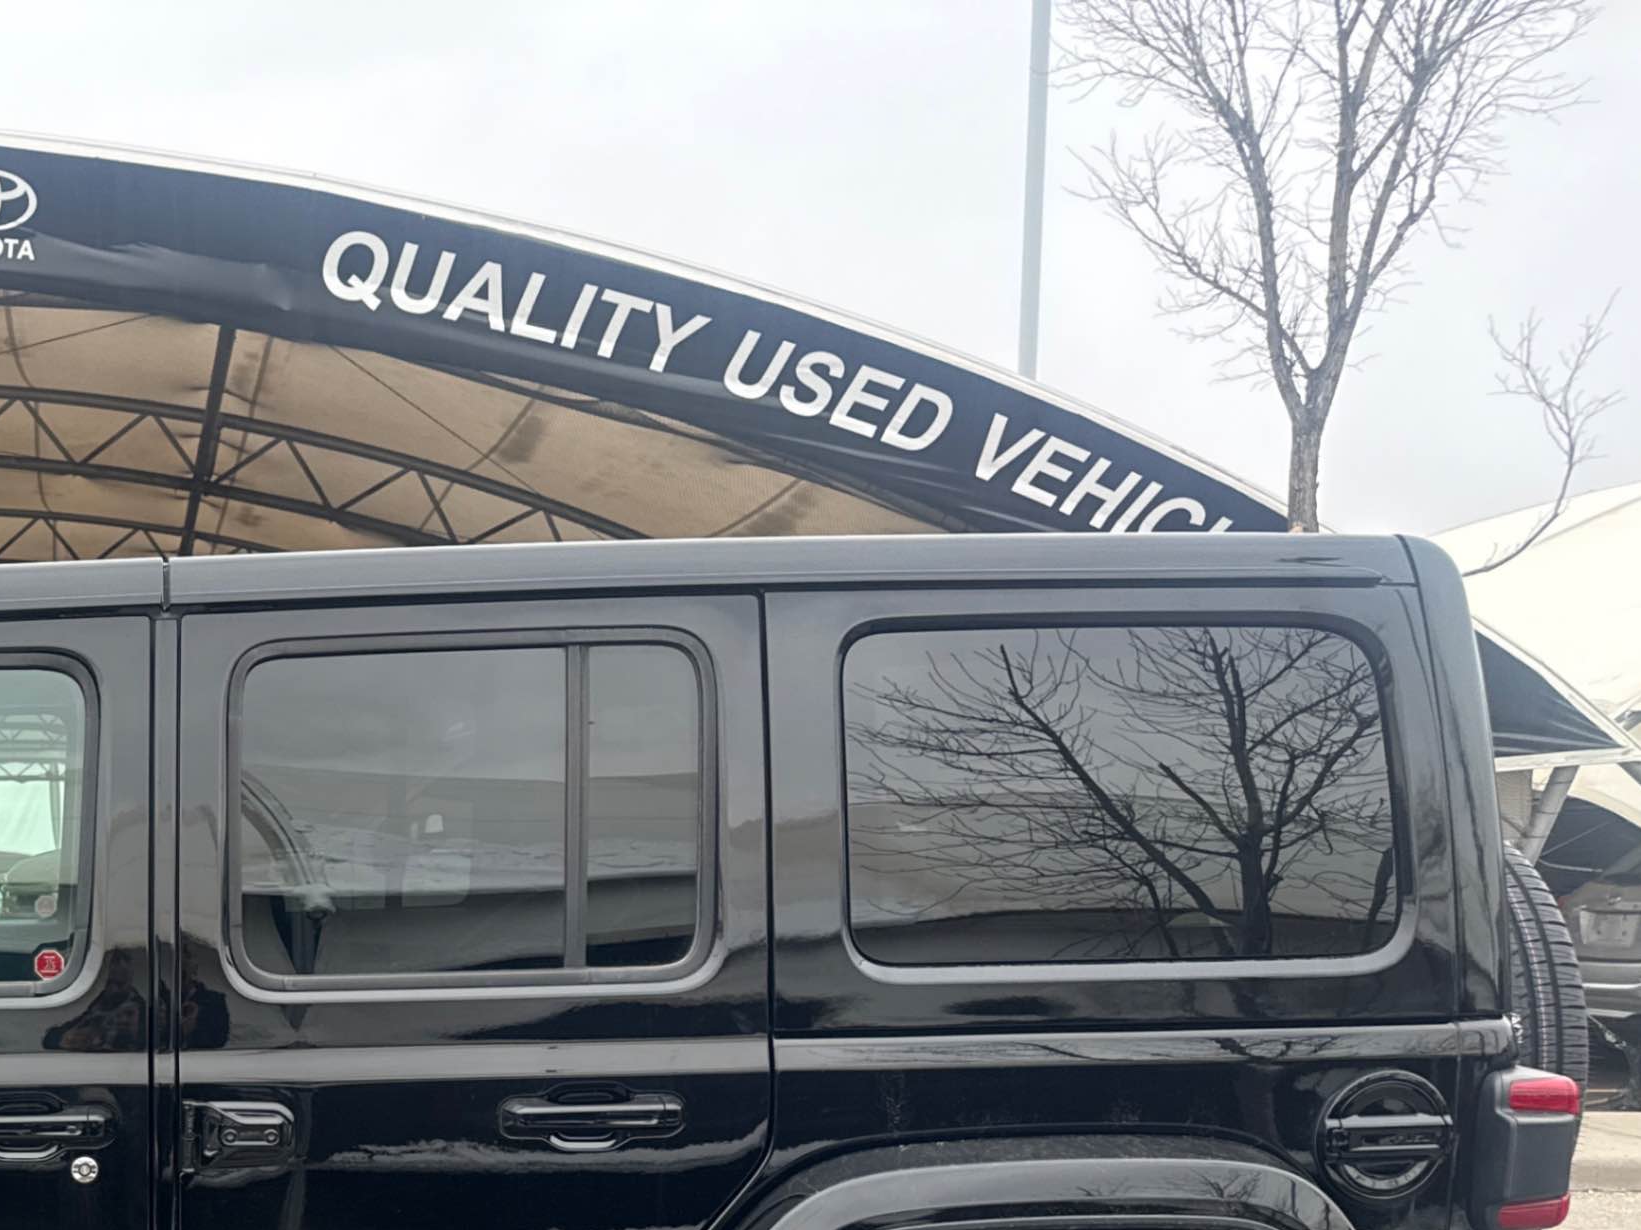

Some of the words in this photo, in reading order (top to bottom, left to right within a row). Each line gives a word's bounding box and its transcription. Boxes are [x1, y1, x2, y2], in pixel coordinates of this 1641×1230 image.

[322, 230, 713, 374] QUALITY
[722, 329, 954, 451] USED
[975, 412, 1234, 533] VEHIC
